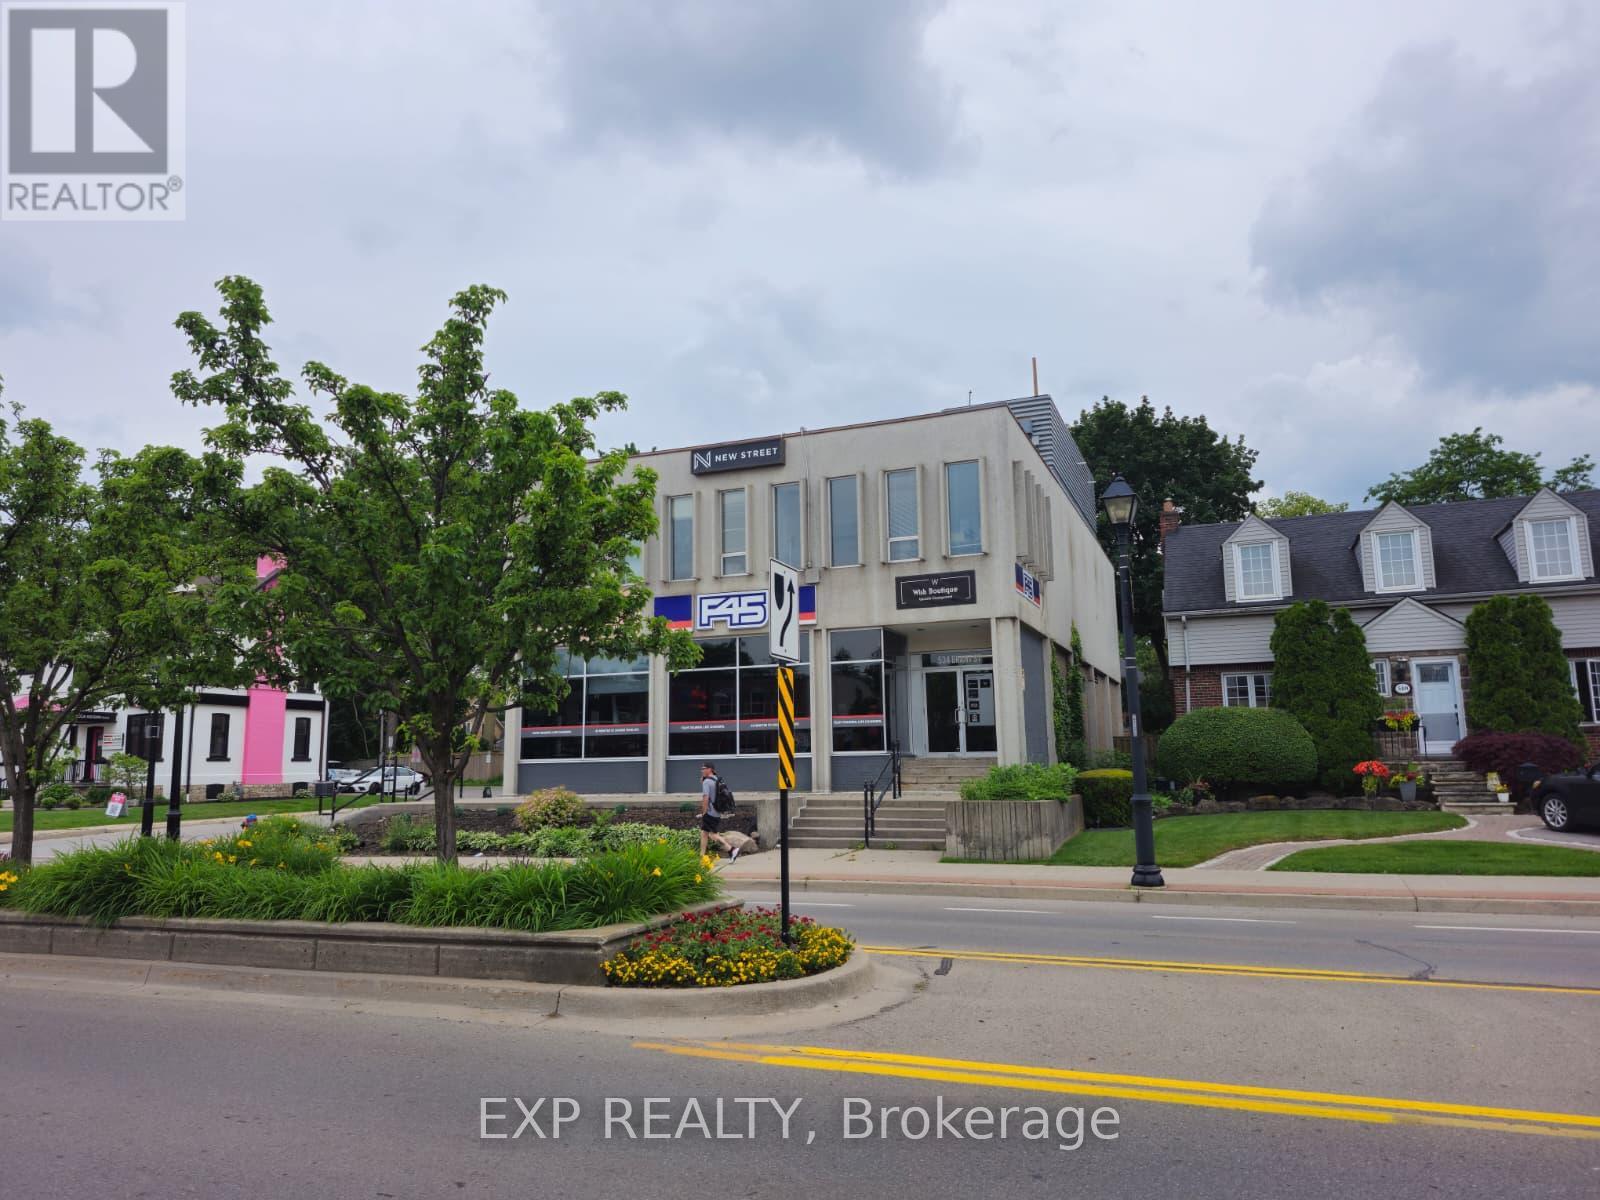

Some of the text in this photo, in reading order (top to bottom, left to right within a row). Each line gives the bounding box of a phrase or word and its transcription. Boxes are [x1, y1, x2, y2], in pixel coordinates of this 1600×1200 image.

[715, 452, 738, 463] NEW
[740, 447, 778, 459] STREET
[928, 586, 959, 595] Boutique
[698, 589, 768, 628] F45
